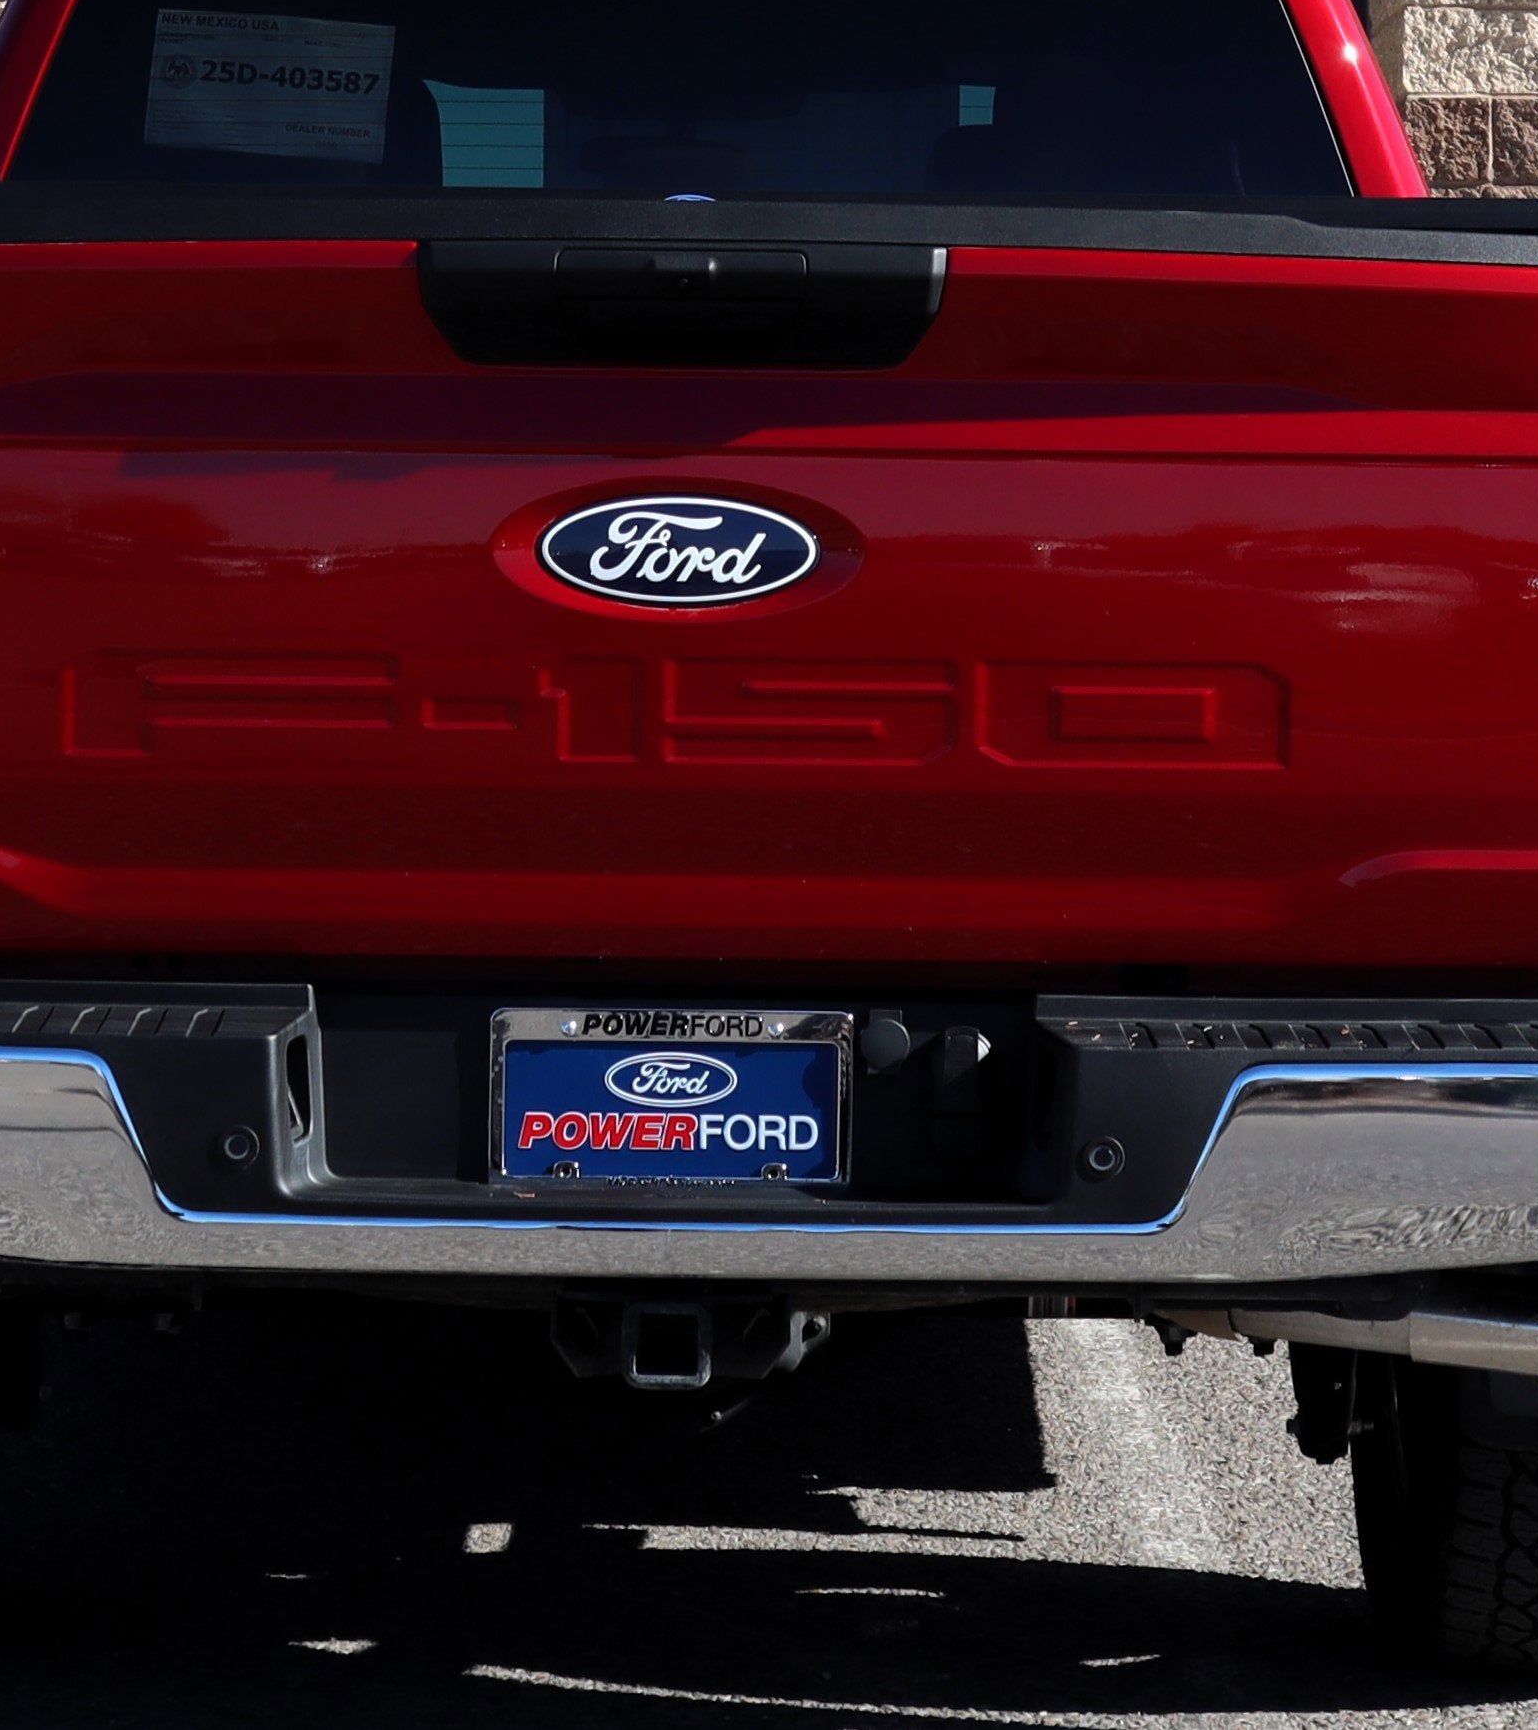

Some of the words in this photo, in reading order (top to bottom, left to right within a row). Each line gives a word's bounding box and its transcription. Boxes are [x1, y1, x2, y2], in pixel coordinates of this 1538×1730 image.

[162, 13, 192, 25] NEW
[195, 15, 248, 29] MEXICO
[250, 19, 280, 31] USA
[199, 59, 380, 96] 25D-403587
[284, 123, 326, 136] DEALER
[327, 125, 372, 139] NUMBER
[590, 511, 767, 584] Ford
[64, 648, 1293, 770] F-150
[631, 1061, 710, 1096] Ford
